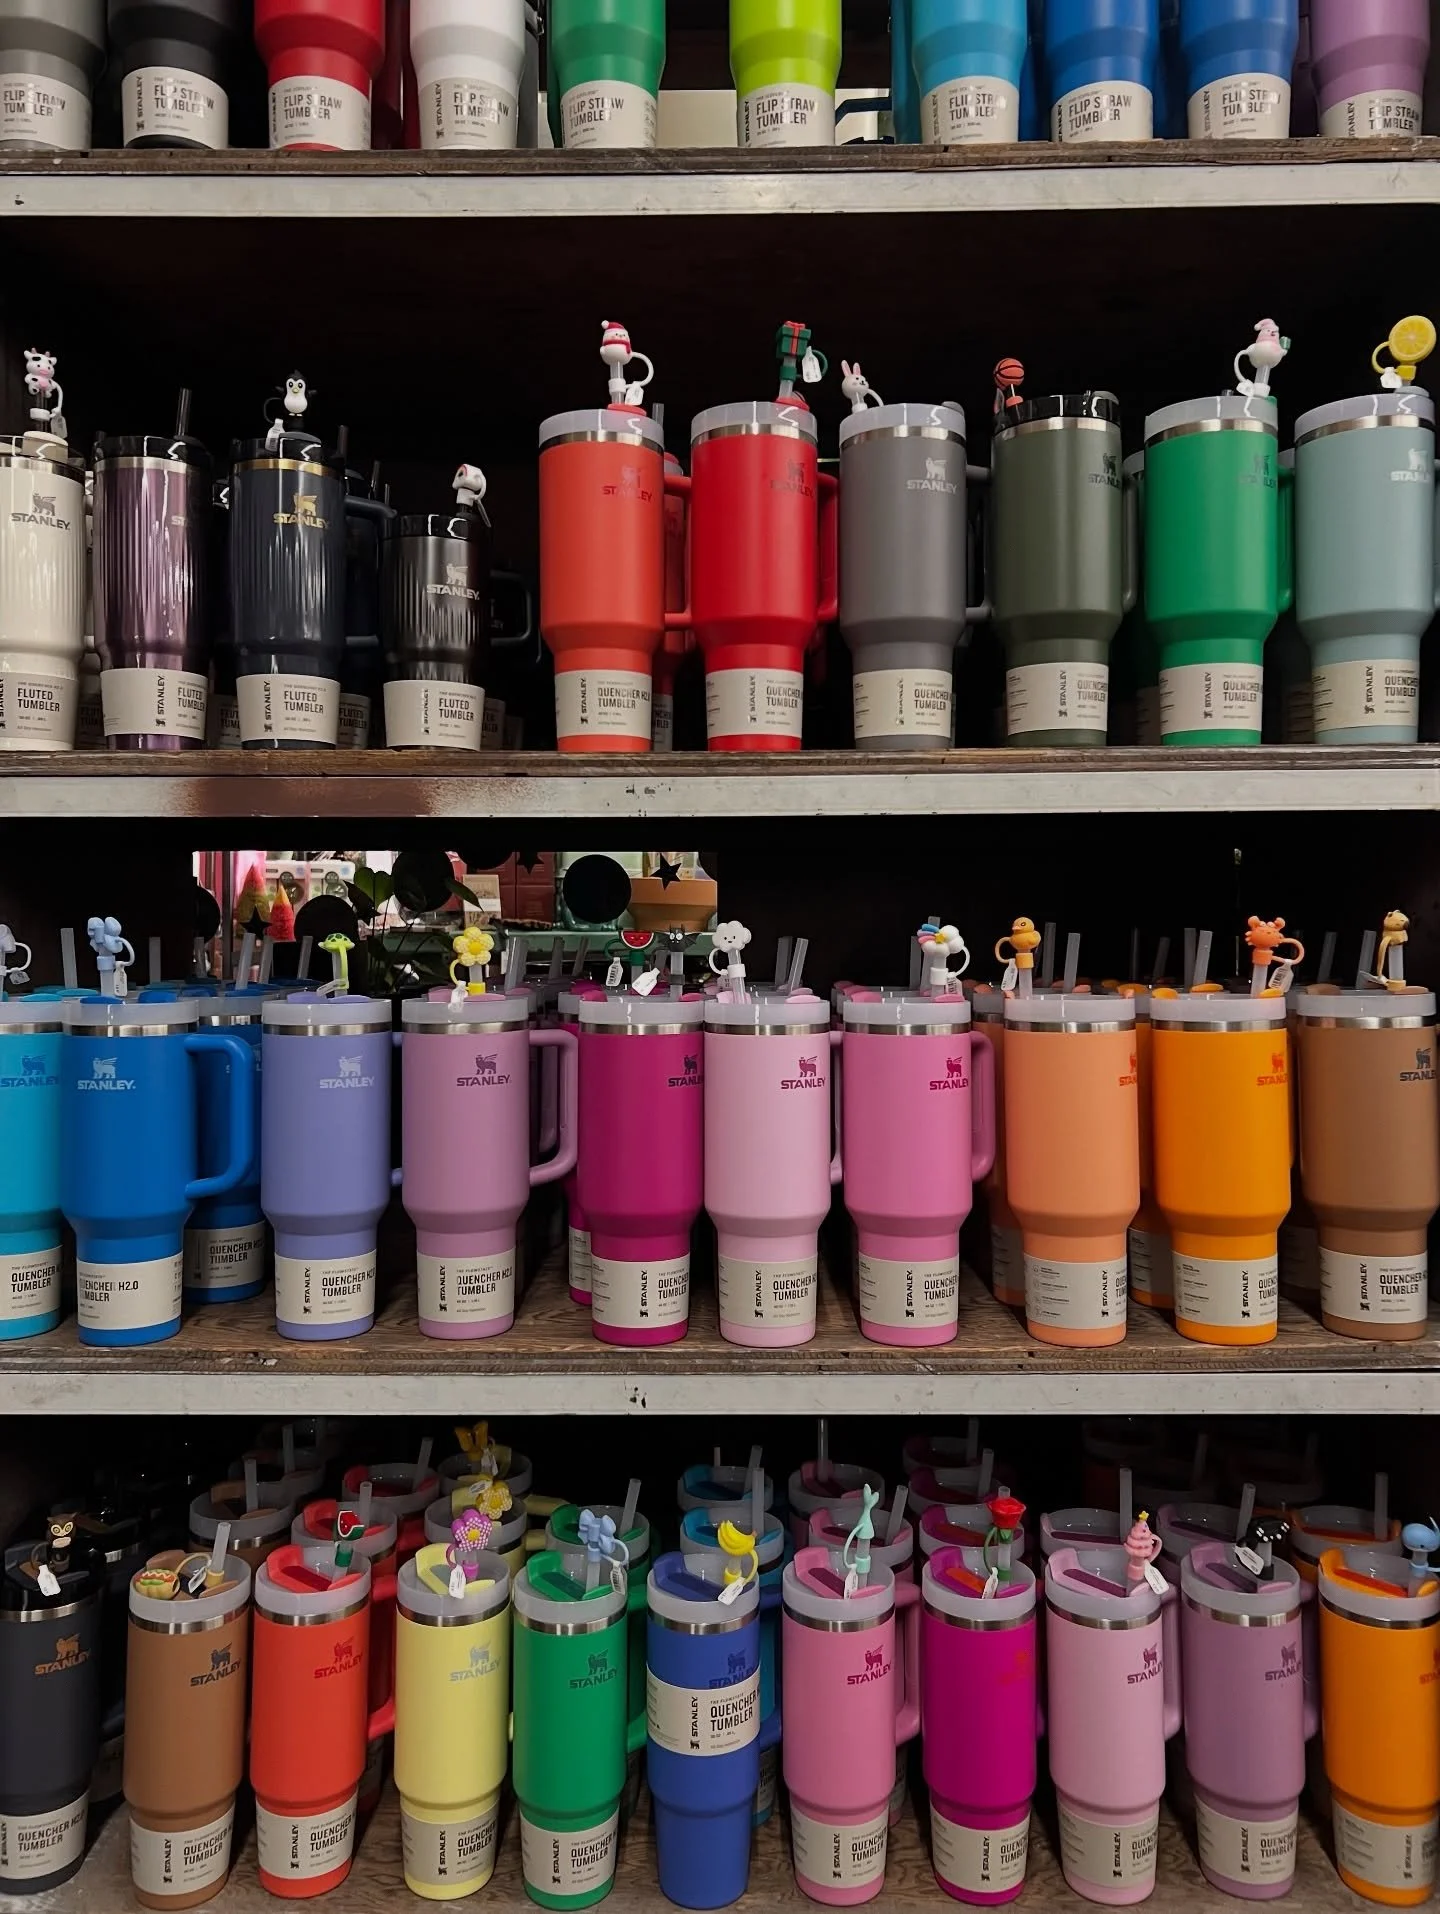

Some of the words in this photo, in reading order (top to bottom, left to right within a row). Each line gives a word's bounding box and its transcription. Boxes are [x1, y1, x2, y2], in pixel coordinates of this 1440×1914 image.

[4, 90, 25, 101] FLIP
[283, 95, 304, 108] FLIP
[306, 94, 343, 109] SRAW
[1222, 90, 1244, 105] FLI
[4, 103, 54, 118] TUMLER
[284, 106, 331, 120] TUMBER
[756, 98, 778, 115] FLIP
[1069, 98, 1091, 118] FLIP
[1093, 94, 1132, 108] SRAW
[1204, 90, 1212, 132] STANLEY
[1369, 105, 1392, 118] FIP
[569, 109, 612, 130] TUMBLE
[1368, 118, 1415, 132] TMBLER
[906, 479, 958, 494] STANLEY
[11, 512, 72, 531] STANLEY
[273, 512, 330, 529] STANLEY
[426, 583, 481, 601] STANLEY
[597, 686, 641, 699] QUENCHER
[1365, 665, 1374, 703] STANLEY
[1384, 686, 1417, 698] TUMBLER
[17, 687, 54, 701] FLUTED
[157, 675, 166, 715] STANLEY
[178, 687, 203, 701] FLUTED
[263, 680, 271, 720] STANLEY
[284, 690, 318, 703] FLUTED
[580, 677, 588, 714] STANLEY
[749, 674, 757, 712] STANLEY
[1077, 690, 1107, 702] TUMBLER
[1222, 691, 1258, 703] TUMBLER
[17, 699, 60, 713] TUMBLER
[284, 700, 324, 714] TUMBLER
[438, 698, 470, 710] FLUTED
[597, 698, 637, 710] TUMBLER
[766, 696, 799, 709] TUMBLER
[914, 699, 947, 711] TUMBLER
[438, 709, 475, 722] TUMBLER
[78, 1079, 137, 1091] STANLEY
[319, 1075, 375, 1089] STANLEY
[456, 1074, 511, 1087] STANLEY
[667, 1075, 704, 1087] STANLE
[780, 1076, 826, 1090] STANLEY
[210, 1241, 253, 1254] QUENCHER
[11, 1265, 56, 1283] QUENCHER
[322, 1271, 366, 1286] QUENCHER
[456, 1271, 501, 1286] QUENCHER
[1359, 1263, 1368, 1300] STANLEY
[1379, 1271, 1422, 1285] QUENCHER
[11, 1277, 52, 1293] TUMBLER
[118, 1280, 139, 1291] H2.0
[304, 1267, 312, 1303] STANLEY
[322, 1283, 361, 1297] TUMBLER
[457, 1283, 496, 1296] TUMBLER
[641, 1270, 649, 1307] STANLEY
[755, 1270, 763, 1307] STANLEY
[773, 1275, 812, 1291] QUENCHER
[906, 1270, 914, 1307] STANLEY
[1241, 1270, 1249, 1307] STANLEY
[1379, 1283, 1419, 1295] TUMBLER
[657, 1284, 687, 1300] TUMBLER
[773, 1287, 809, 1301] TUMBLER
[924, 1287, 955, 1301] TUMBLER
[34, 1649, 92, 1676] STANLEY
[313, 1653, 364, 1679] STANLEY
[449, 1655, 502, 1682] STANLEY
[190, 1657, 242, 1687] STANLEY
[569, 1666, 619, 1689] STANLEY
[847, 1661, 893, 1685] STANLEY
[710, 1689, 757, 1719] QUENCHER
[691, 1696, 699, 1738] STANLEY
[710, 1706, 754, 1732] TUMBLER
[17, 1820, 70, 1842] QUENCHER
[310, 1815, 352, 1842] QUENCHER
[17, 1834, 64, 1852] TUMBLER
[183, 1829, 228, 1856] QUENCHER
[310, 1828, 348, 1852] TUMBLER
[439, 1830, 447, 1866] STANLEY
[457, 1834, 493, 1858] TUMBLER
[571, 1833, 613, 1858] QUENCHER
[1241, 1827, 1249, 1863] STANLEY
[164, 1838, 172, 1874] STANLEY
[183, 1841, 223, 1866] TUMBLER
[552, 1838, 560, 1874] STANLEY
[571, 1846, 609, 1868] TUMBLER
[833, 1833, 841, 1869] STANLEY
[982, 1836, 991, 1871] STANLEY
[1113, 1831, 1121, 1868] STANLEY
